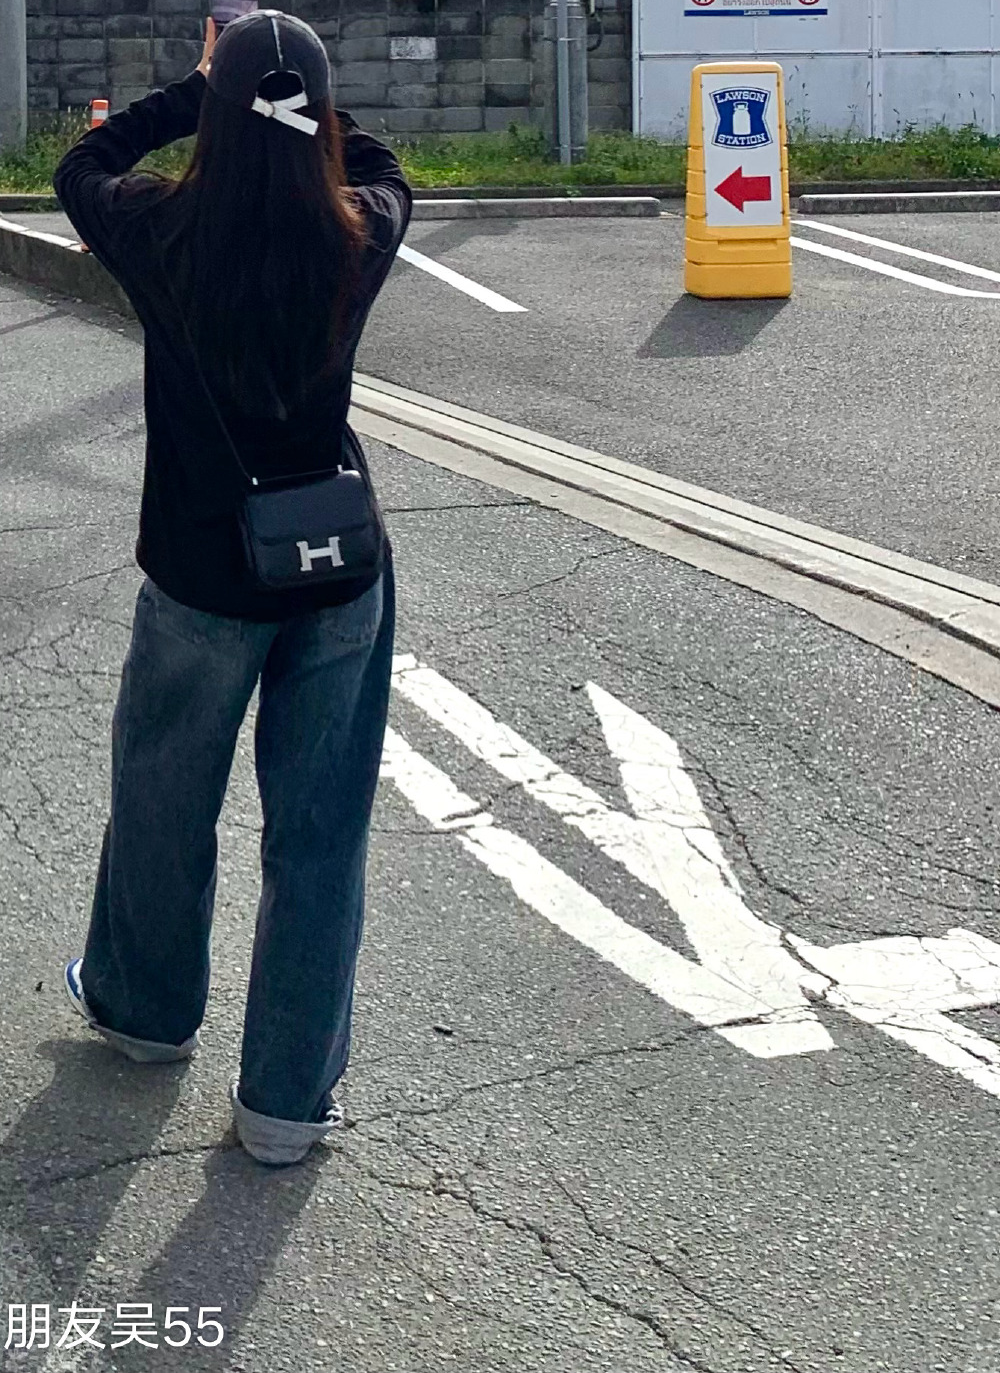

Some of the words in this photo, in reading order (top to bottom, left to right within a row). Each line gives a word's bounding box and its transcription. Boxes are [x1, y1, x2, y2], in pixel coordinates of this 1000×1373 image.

[715, 91, 766, 103] LAWSON
[717, 133, 767, 145] STATION
[296, 536, 345, 572] H
